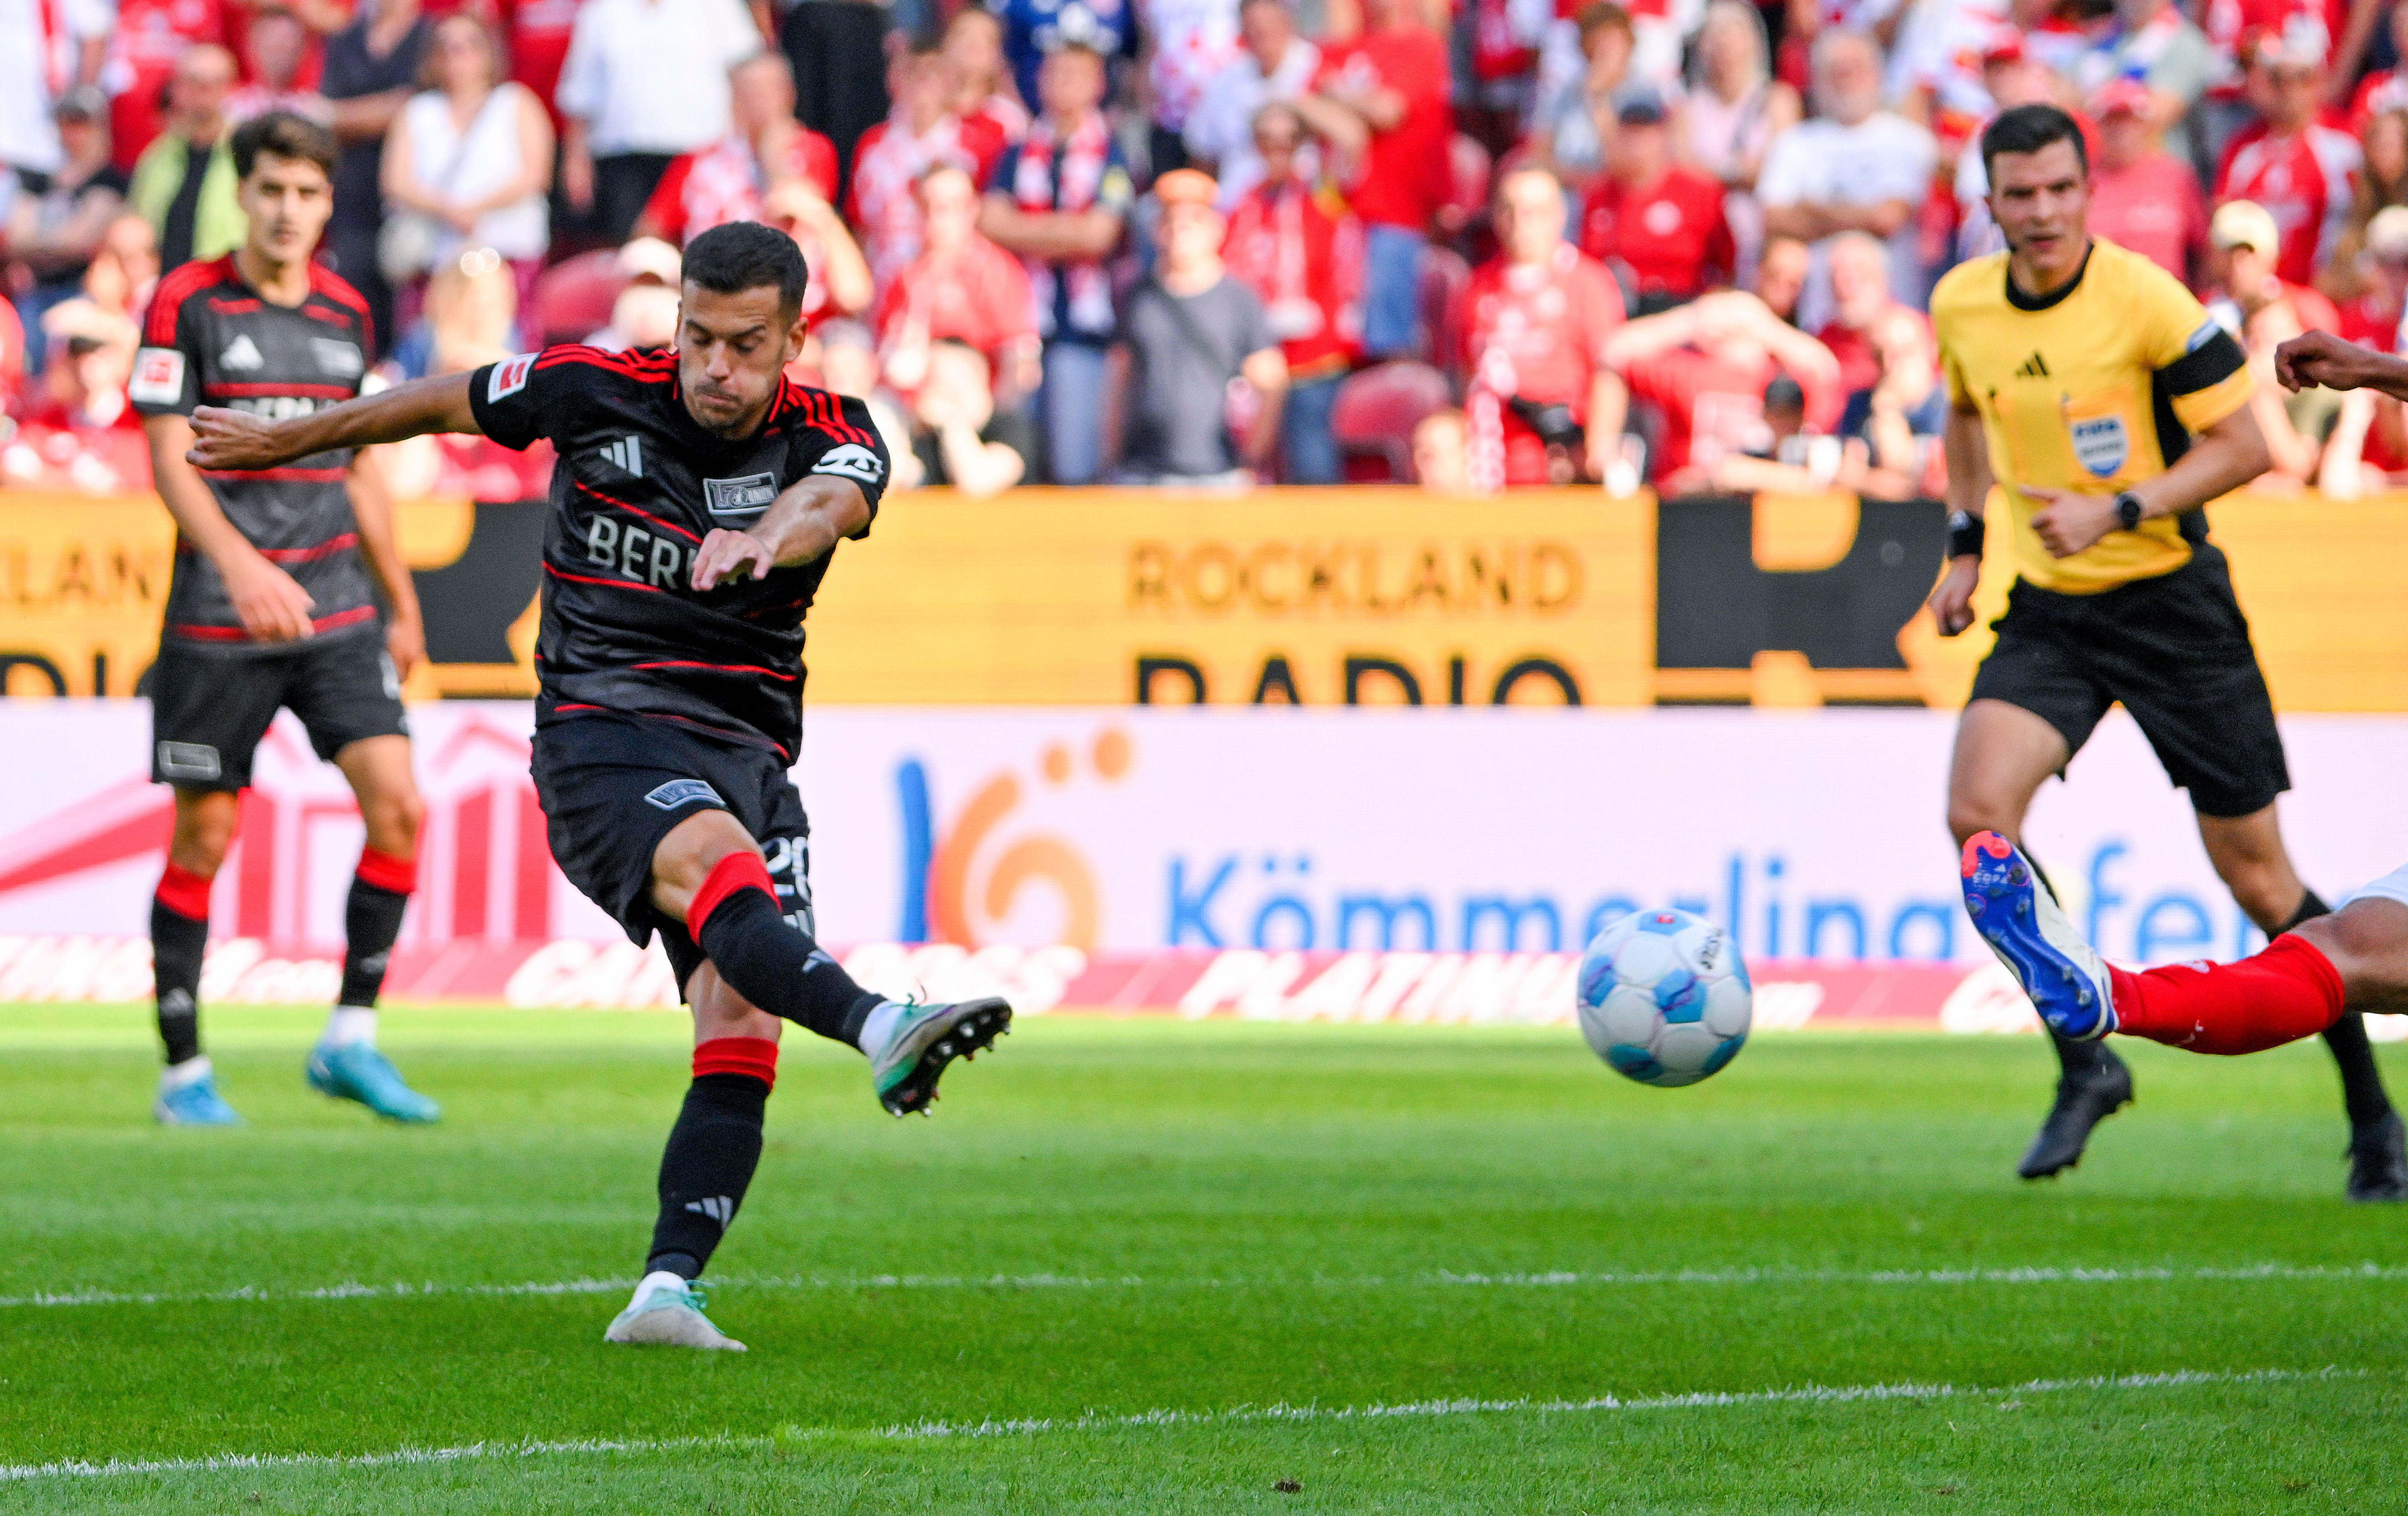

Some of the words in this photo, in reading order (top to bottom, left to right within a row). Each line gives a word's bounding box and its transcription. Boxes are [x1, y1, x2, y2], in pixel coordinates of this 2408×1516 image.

[1127, 540, 1584, 615] ROCKLAND
[1169, 851, 1955, 960] Kömmling
[1178, 949, 1579, 1026] PLATINU
